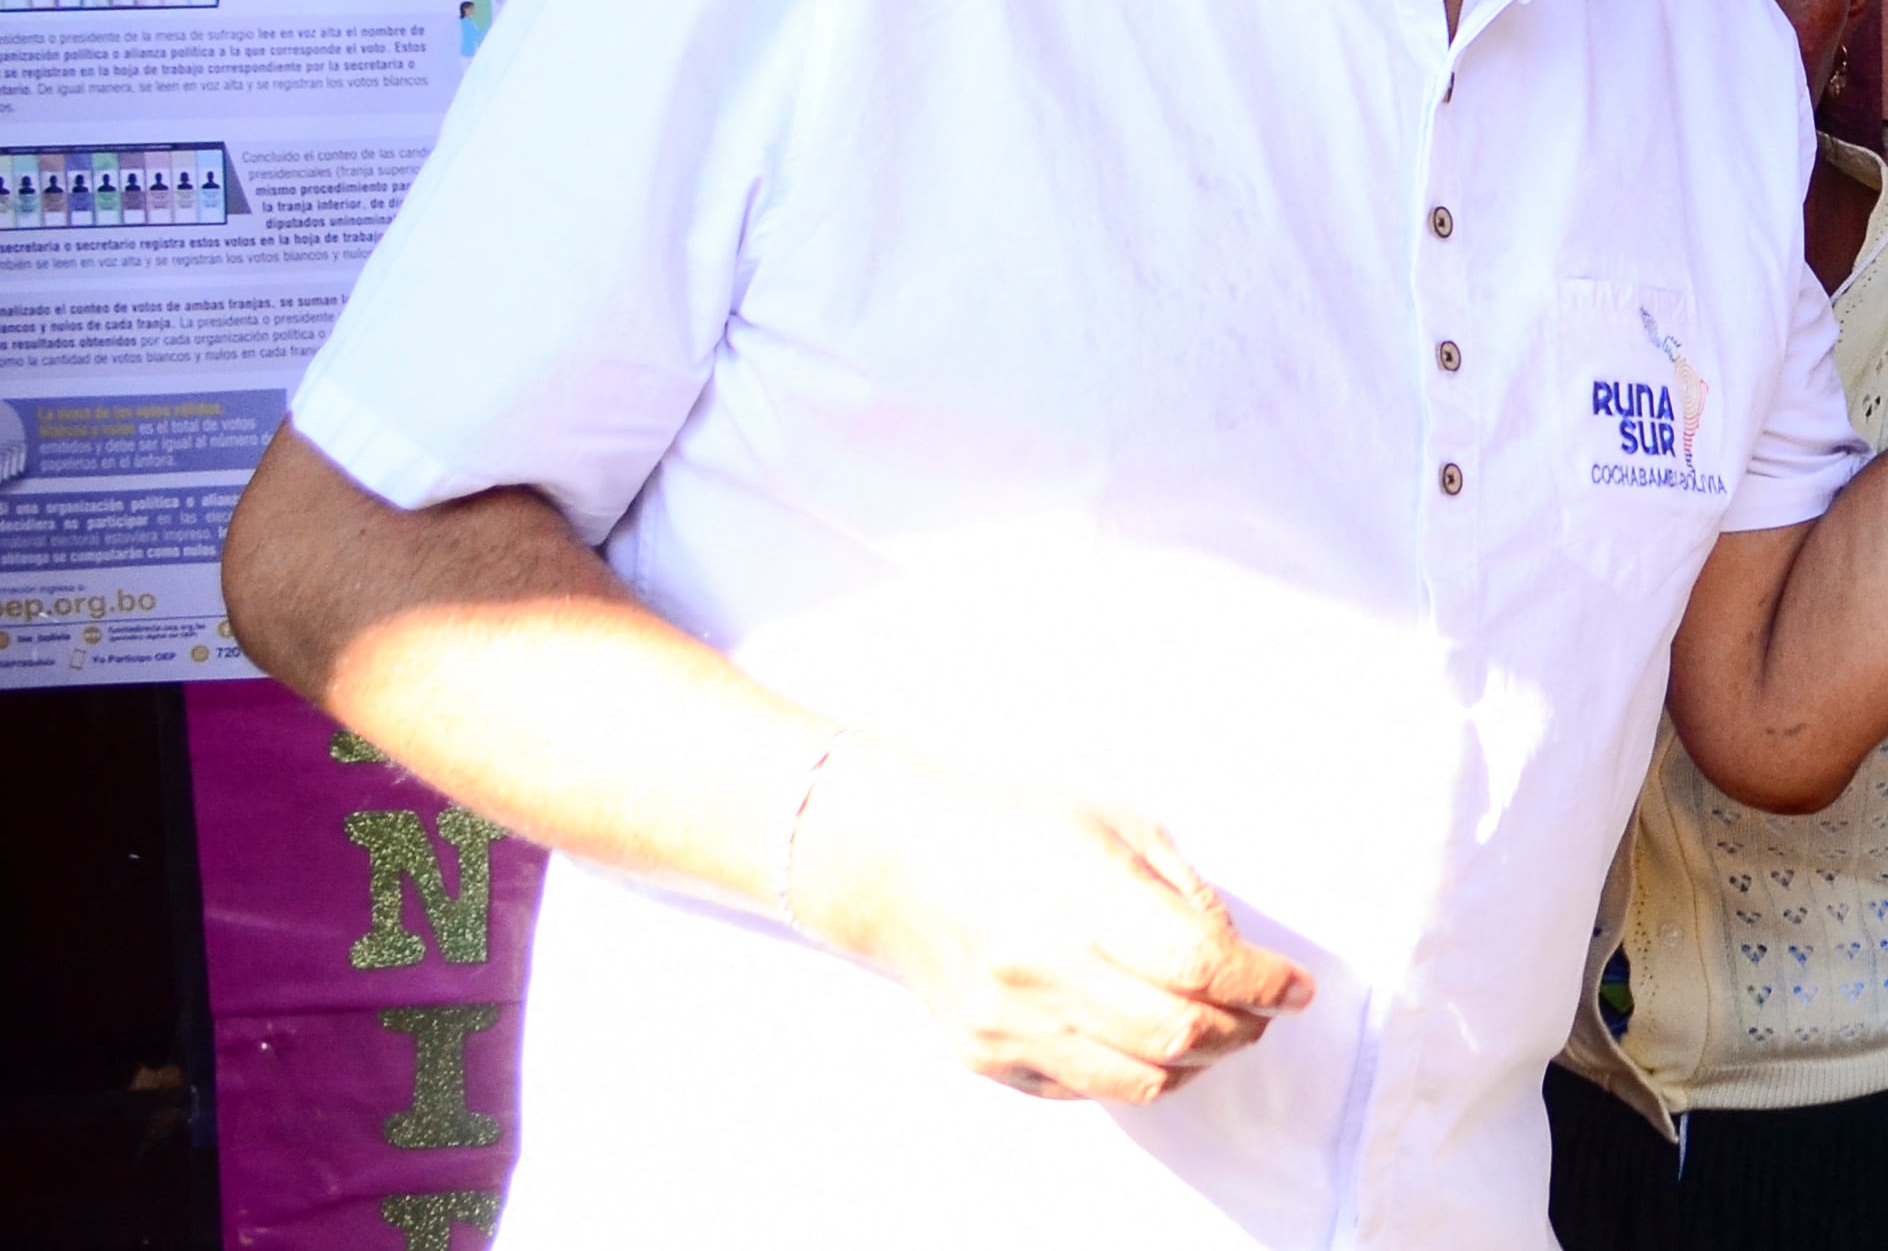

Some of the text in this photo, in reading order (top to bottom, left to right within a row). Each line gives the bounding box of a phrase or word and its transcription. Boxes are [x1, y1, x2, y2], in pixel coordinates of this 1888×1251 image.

[300, 181, 388, 196] procedimiento
[1593, 381, 1674, 421] RUNA
[1619, 419, 1676, 457] SUR
